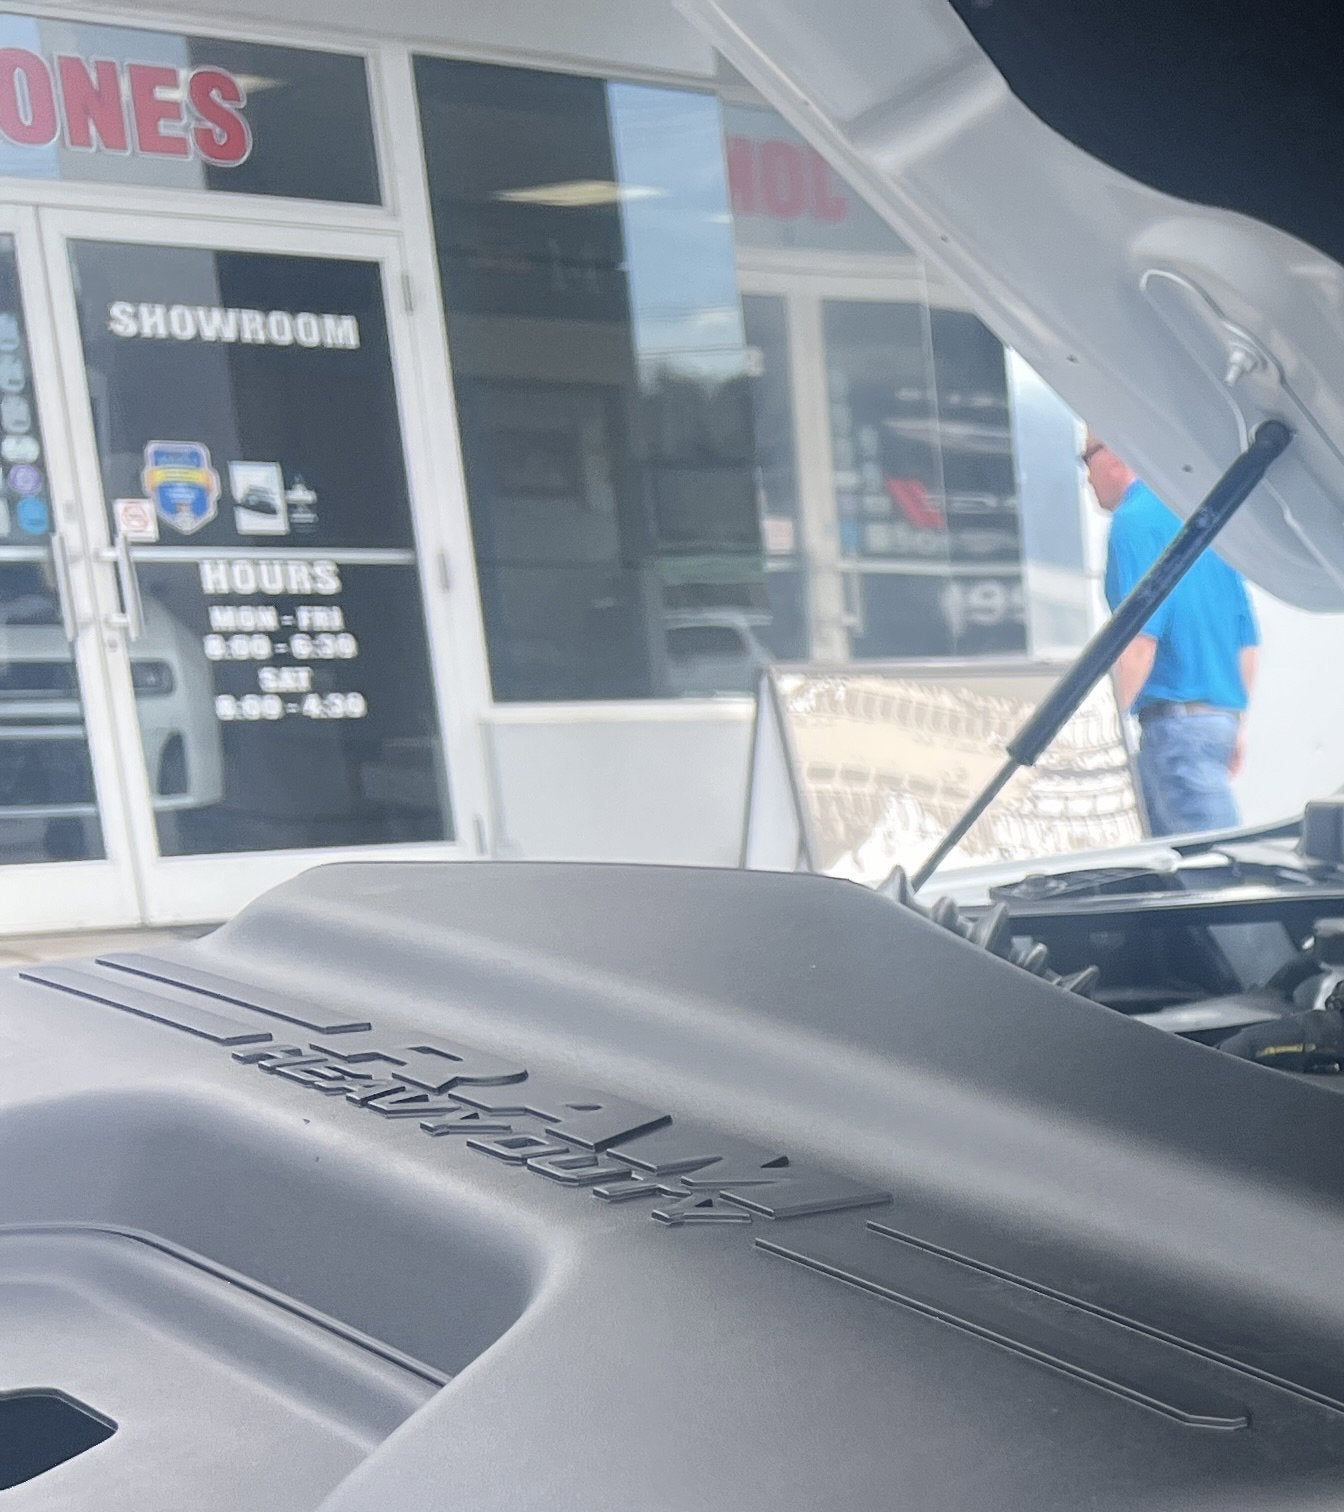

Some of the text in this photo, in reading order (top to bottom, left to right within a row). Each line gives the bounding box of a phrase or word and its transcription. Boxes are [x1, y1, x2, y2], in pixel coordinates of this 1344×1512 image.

[108, 300, 360, 350] SHOWROOM
[199, 559, 342, 595] HOURS
[257, 666, 314, 693] SAT
[230, 1044, 752, 1226] HEAVY DUTY
